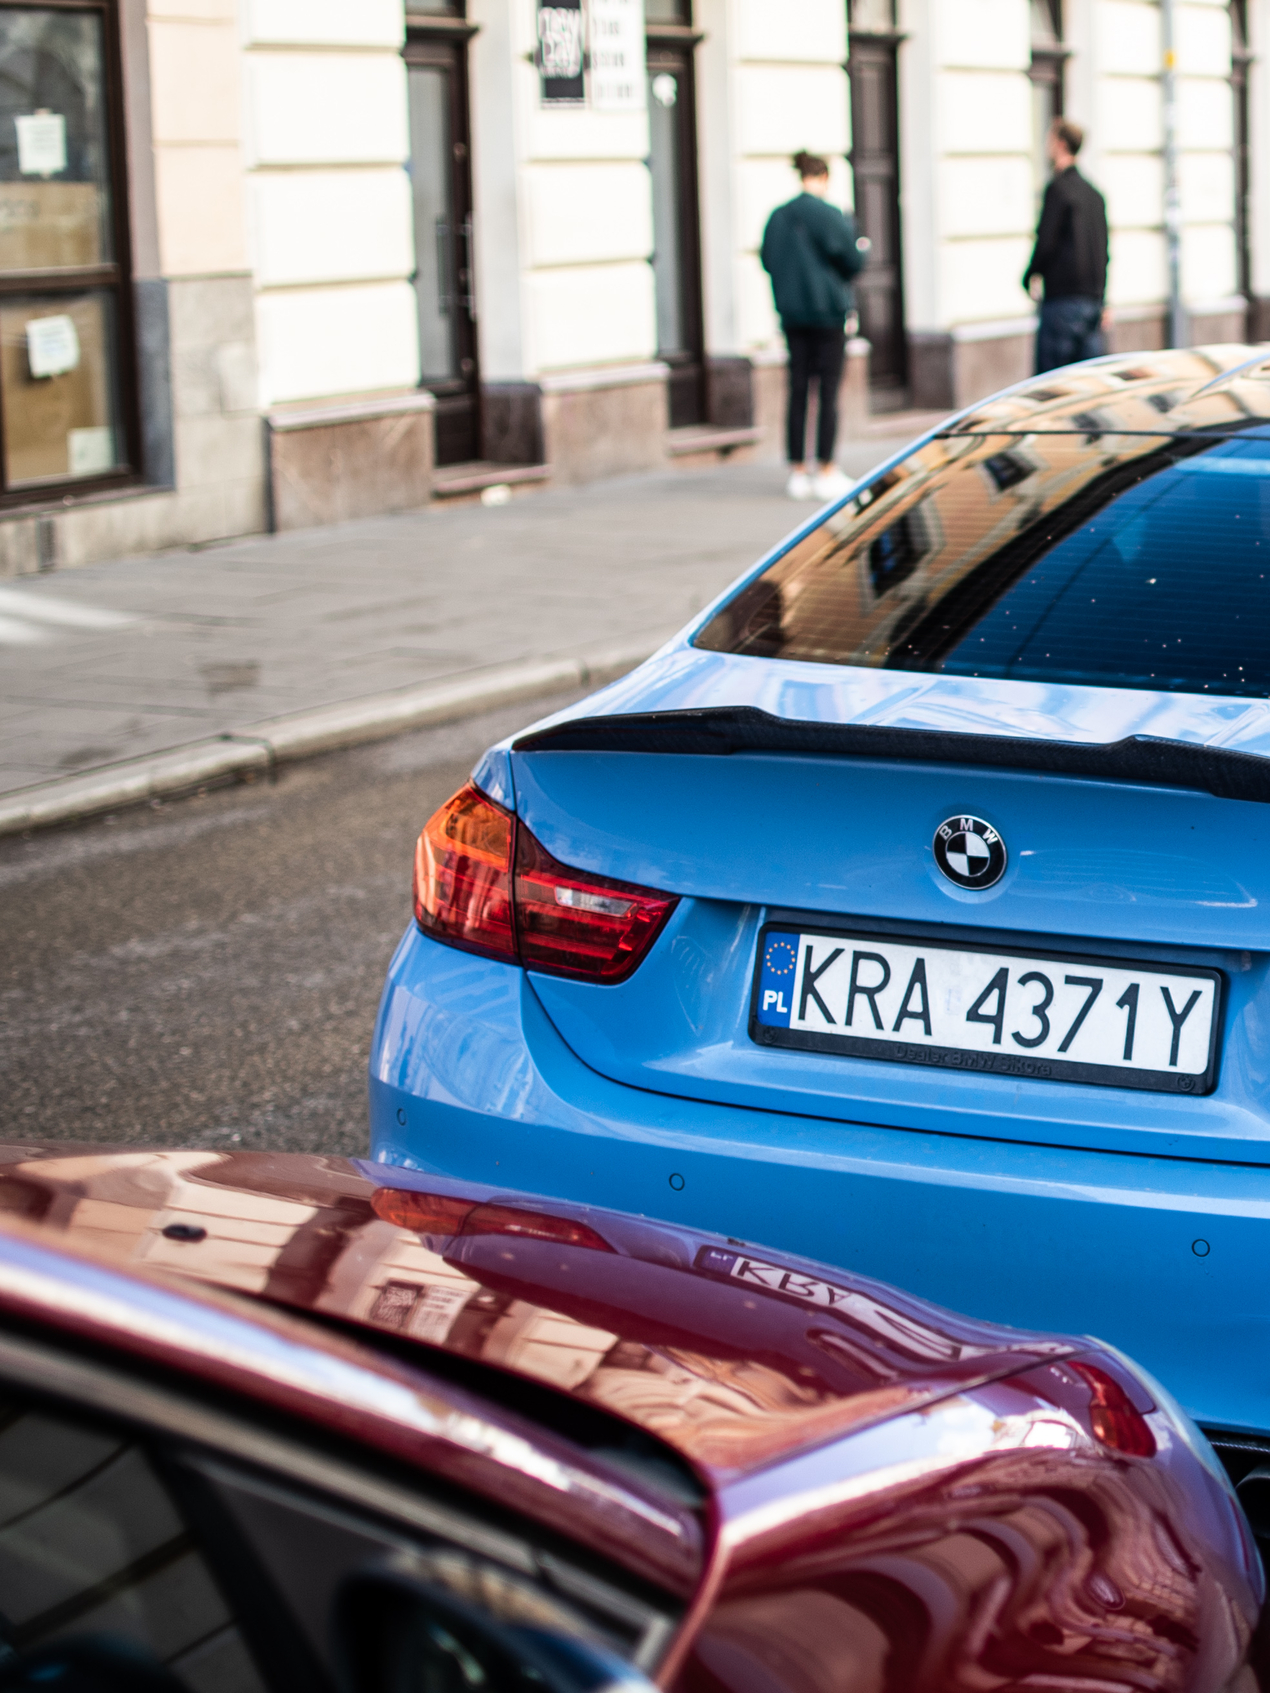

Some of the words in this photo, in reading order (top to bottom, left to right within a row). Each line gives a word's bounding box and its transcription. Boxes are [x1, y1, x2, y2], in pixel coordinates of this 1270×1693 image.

[939, 818, 998, 844] BMW
[763, 989, 788, 1013] PL
[798, 945, 933, 1036] KRA
[966, 967, 1203, 1068] 4371Y
[895, 1045, 947, 1065] Dealer
[951, 1051, 997, 1070] BMW
